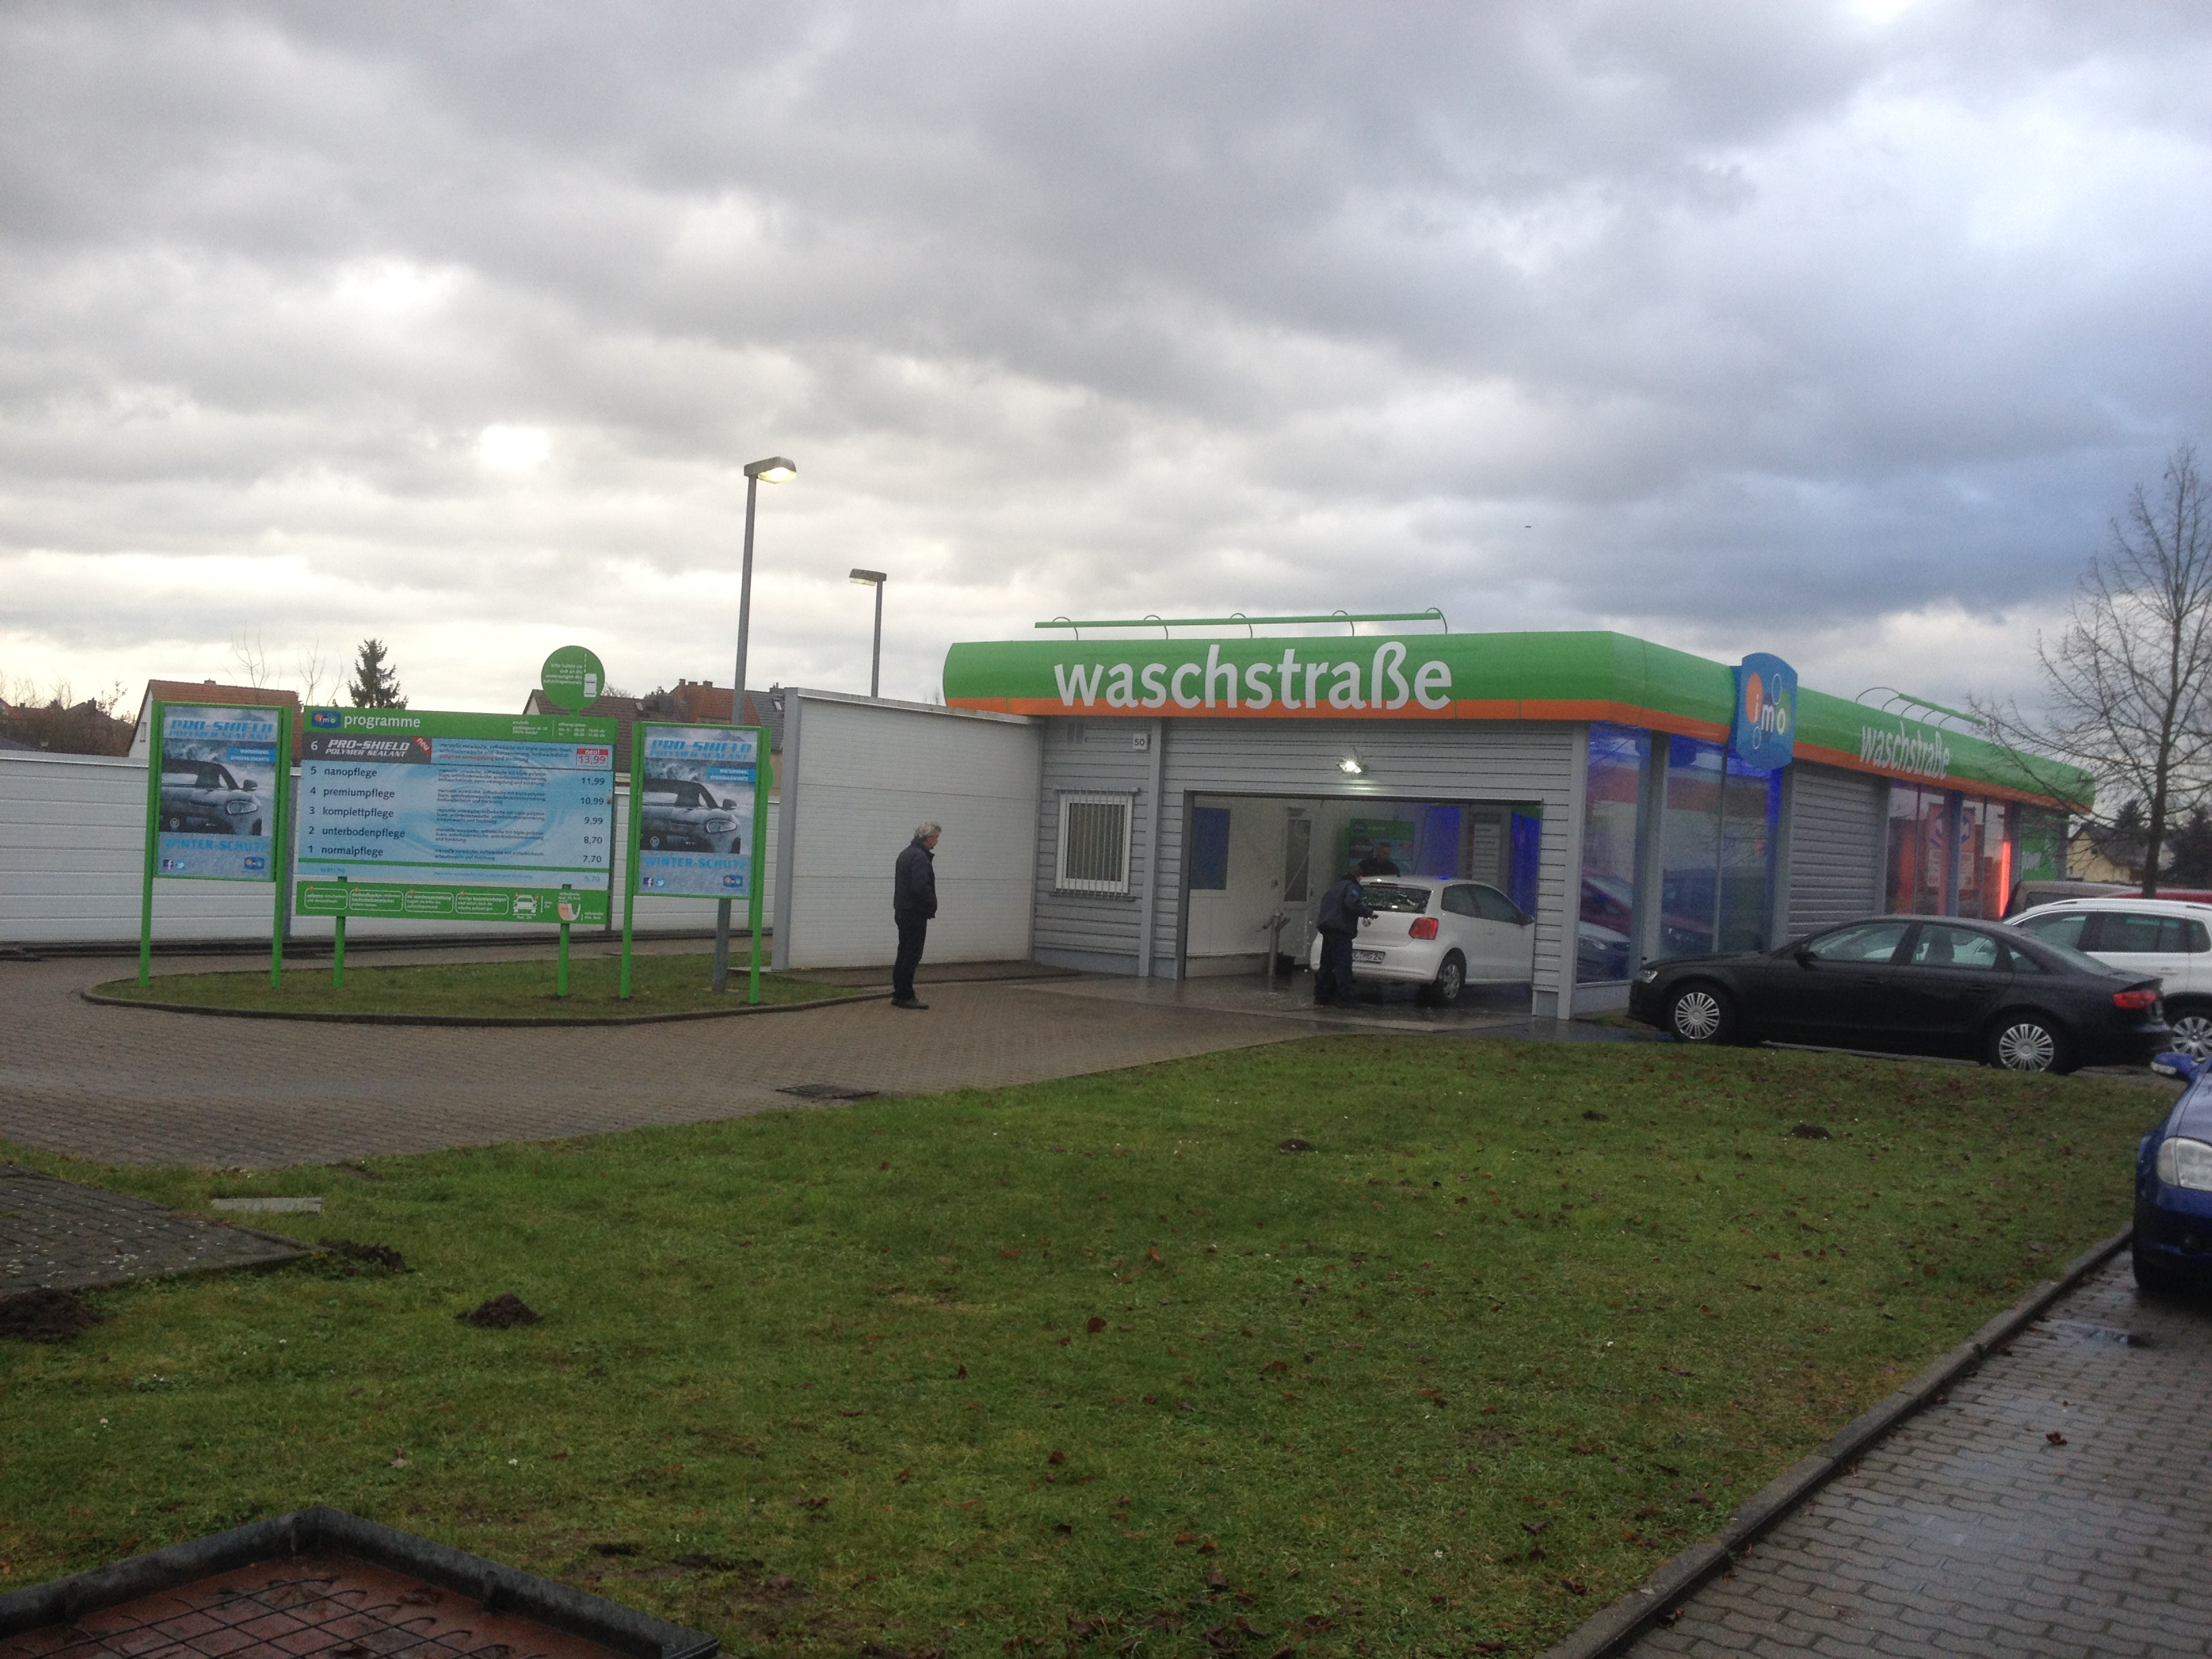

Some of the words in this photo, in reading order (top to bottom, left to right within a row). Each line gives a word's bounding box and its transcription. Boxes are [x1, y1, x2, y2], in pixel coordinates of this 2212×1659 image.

[1054, 641, 1452, 711] waschstraße
[1754, 693, 1786, 735] imo
[344, 715, 421, 729] programme
[310, 741, 319, 750] 6
[327, 739, 410, 751] PRO-SHIELD
[416, 737, 430, 752] neu
[1134, 738, 1145, 746] 50
[367, 750, 407, 758] SEALANT
[1859, 720, 1950, 780] waschstraße
[578, 755, 606, 765] 13,99
[310, 766, 316, 775] 5
[324, 767, 377, 779] nanopflege
[581, 777, 605, 785] 11,99
[310, 786, 316, 794] 4
[323, 787, 395, 800] premiumpflege
[580, 797, 605, 806] 10,99
[309, 806, 315, 815] 3
[323, 806, 394, 819] komplettpflege
[584, 817, 603, 825] 9,99
[308, 826, 314, 834] 2
[322, 826, 405, 840] unterbodenpflege
[164, 838, 268, 852] WINTER-SCHUTZ
[583, 836, 602, 845] 8,70
[308, 845, 313, 853] 1
[321, 846, 384, 858] normalpflege
[583, 855, 602, 863] 7,70
[644, 857, 747, 870] WINTER-SCHUTZ
